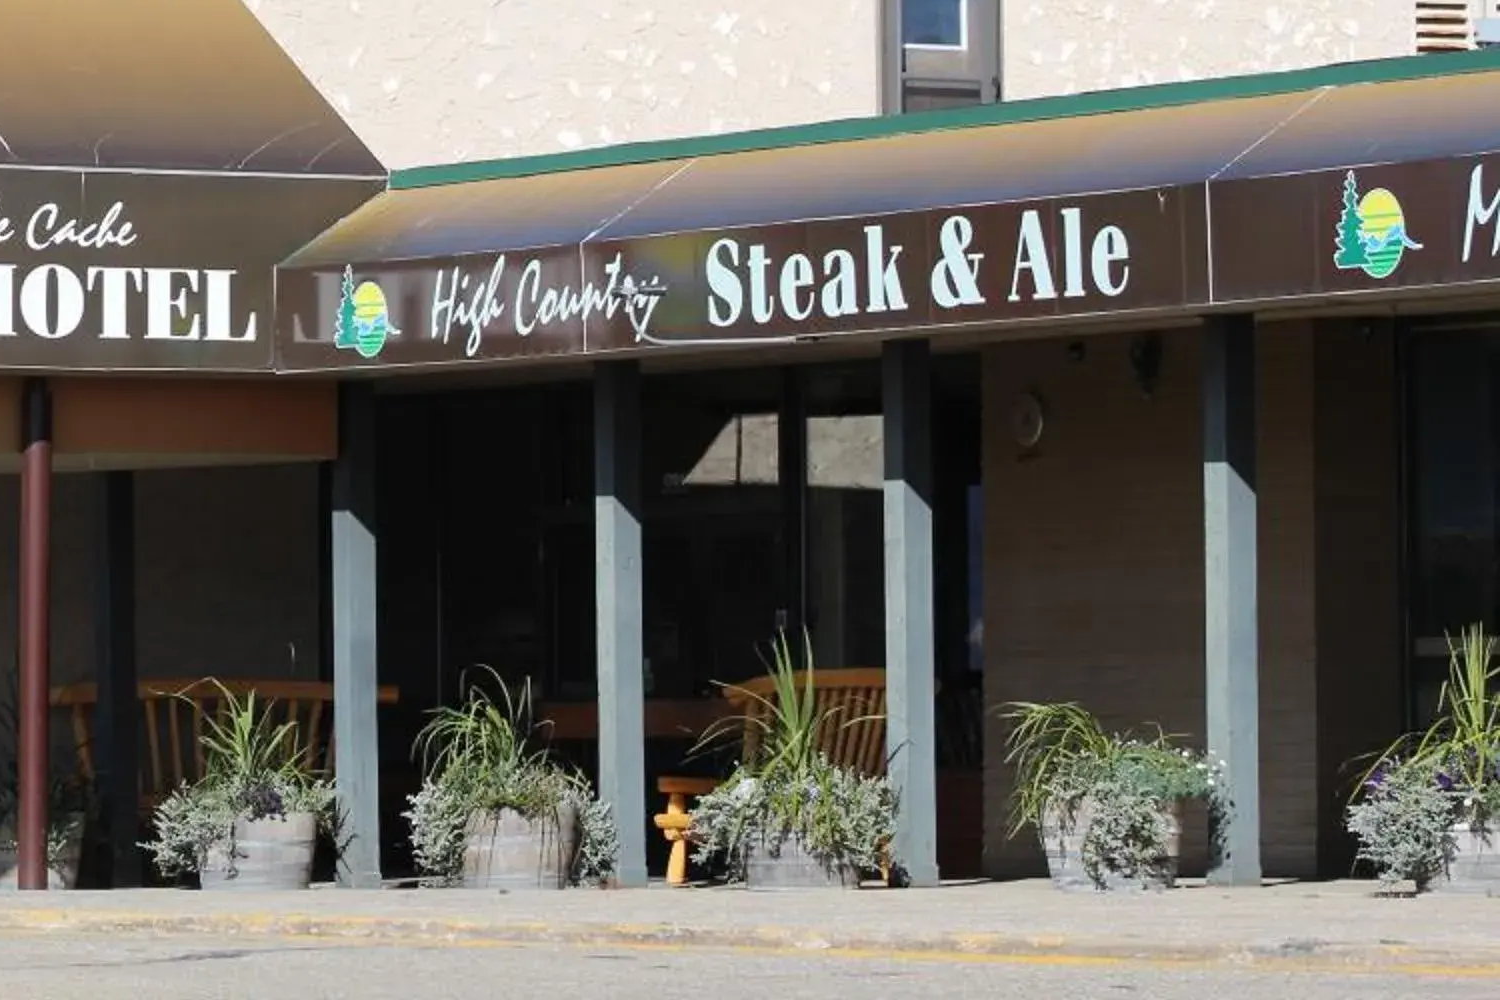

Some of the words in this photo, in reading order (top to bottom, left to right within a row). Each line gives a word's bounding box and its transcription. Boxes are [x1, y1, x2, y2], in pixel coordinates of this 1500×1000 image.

[25, 202, 137, 250] Cache
[431, 255, 505, 357] High
[705, 225, 908, 328] Steak
[931, 215, 986, 309] &
[1008, 207, 1130, 301] Ale
